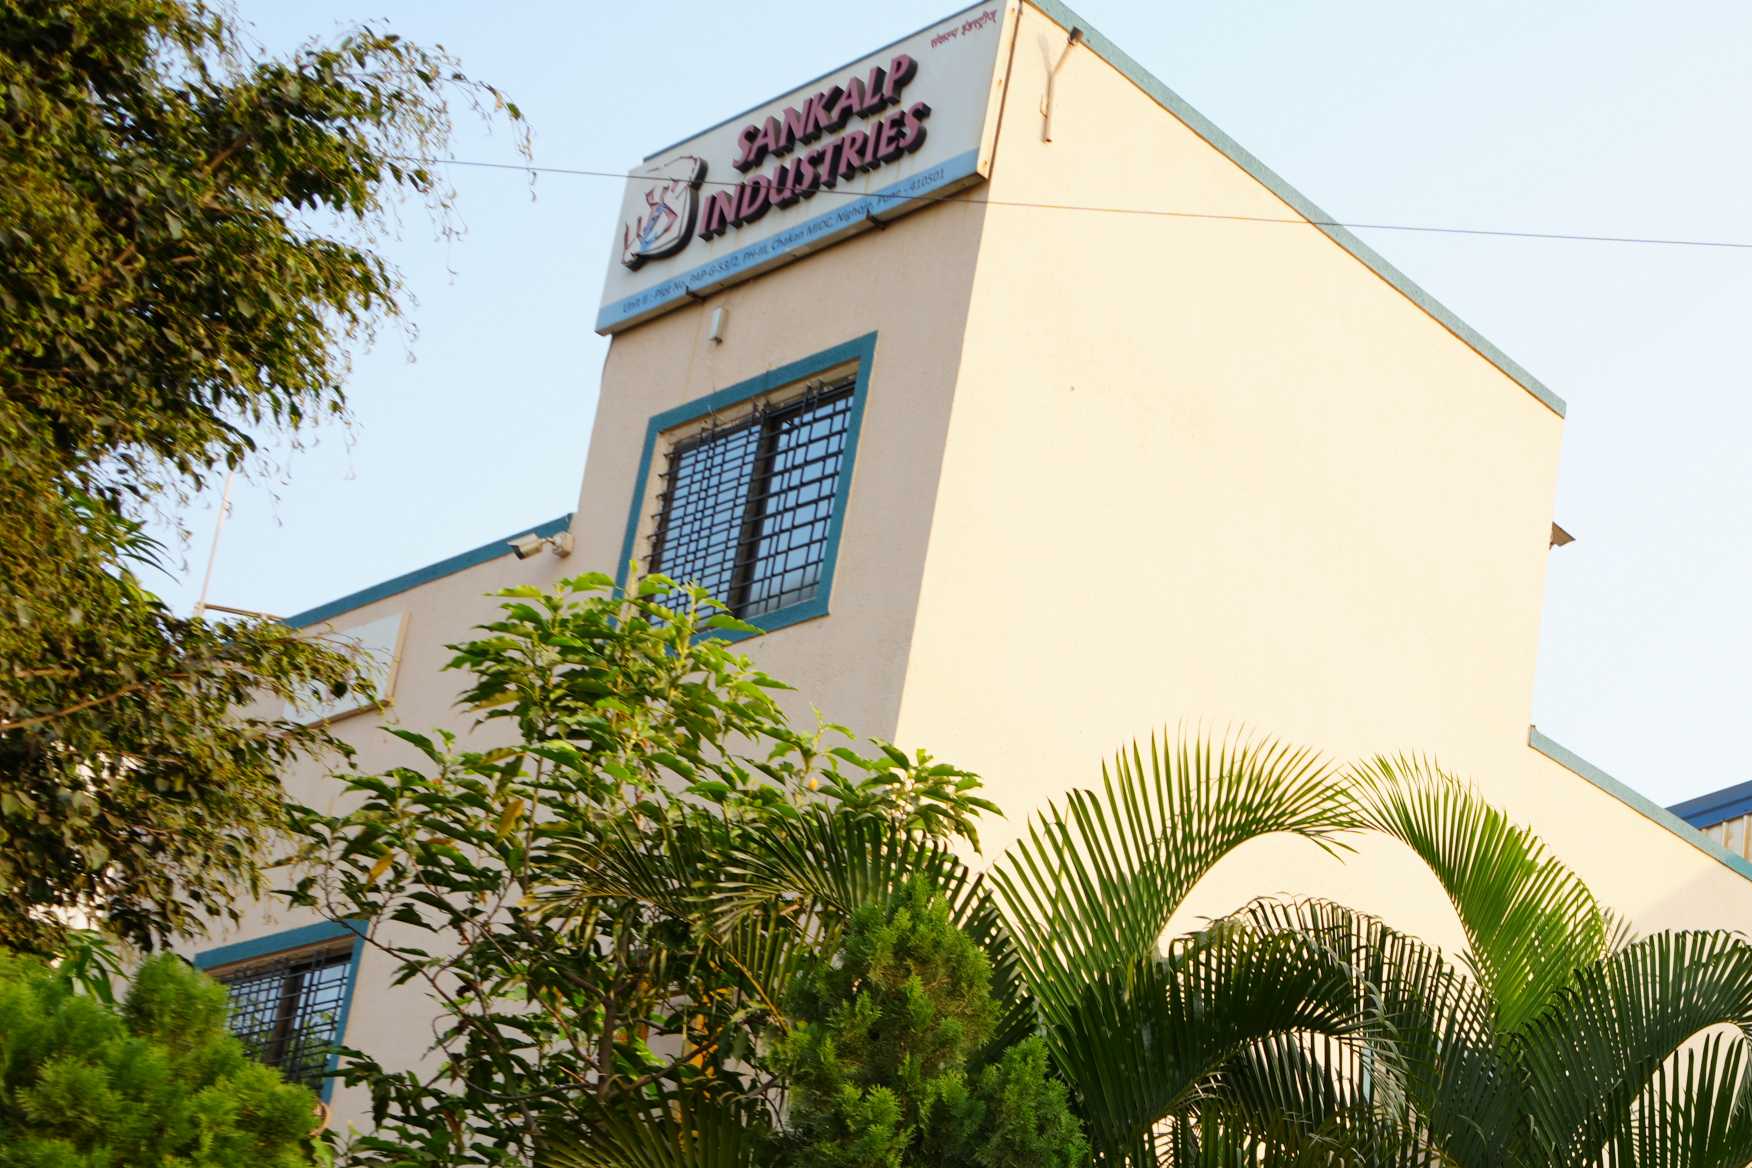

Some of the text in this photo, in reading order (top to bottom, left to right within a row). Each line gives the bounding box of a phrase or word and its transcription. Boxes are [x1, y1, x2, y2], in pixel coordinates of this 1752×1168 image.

[698, 101, 932, 241] INDUSTRIES
[732, 54, 918, 173] SANKALP
[910, 168, 945, 192] 410501
